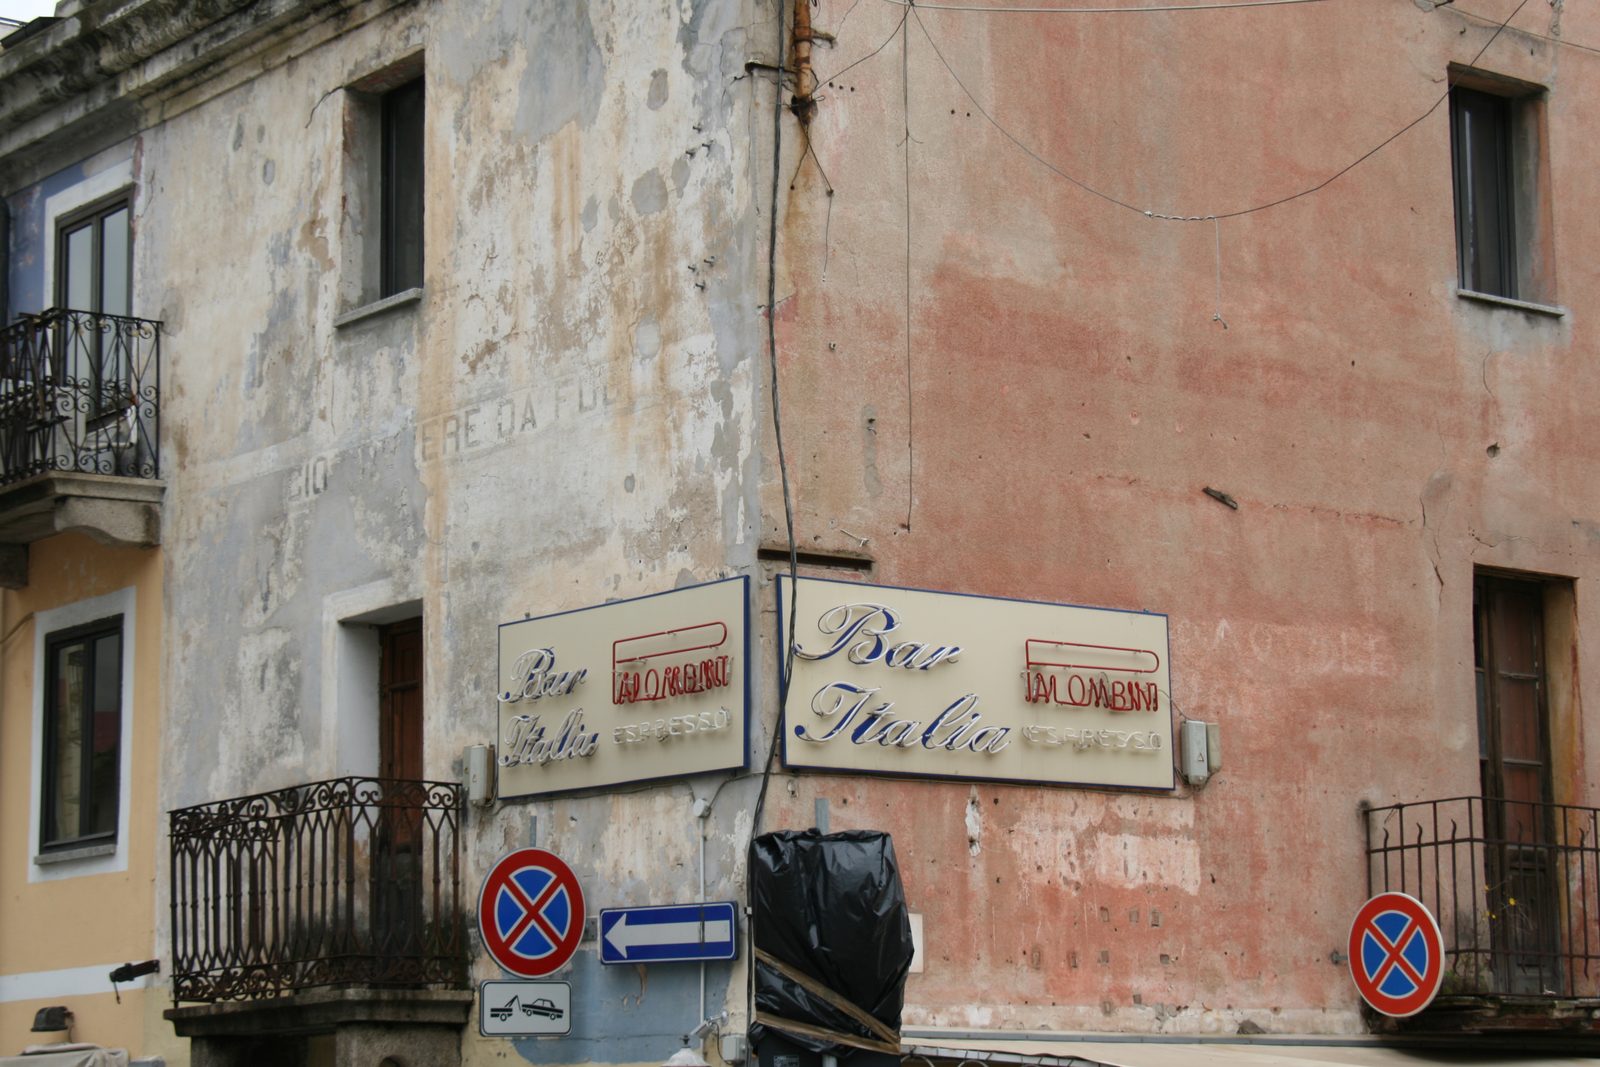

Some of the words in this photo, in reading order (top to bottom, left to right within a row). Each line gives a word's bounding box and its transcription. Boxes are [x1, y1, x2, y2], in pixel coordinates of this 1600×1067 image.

[792, 602, 965, 670] Bar
[498, 647, 588, 703] Bar
[498, 708, 600, 768] Italia
[612, 707, 731, 744] ESPRESSO
[794, 681, 1012, 754] Italia
[1022, 724, 1162, 751] ESPRESSO
